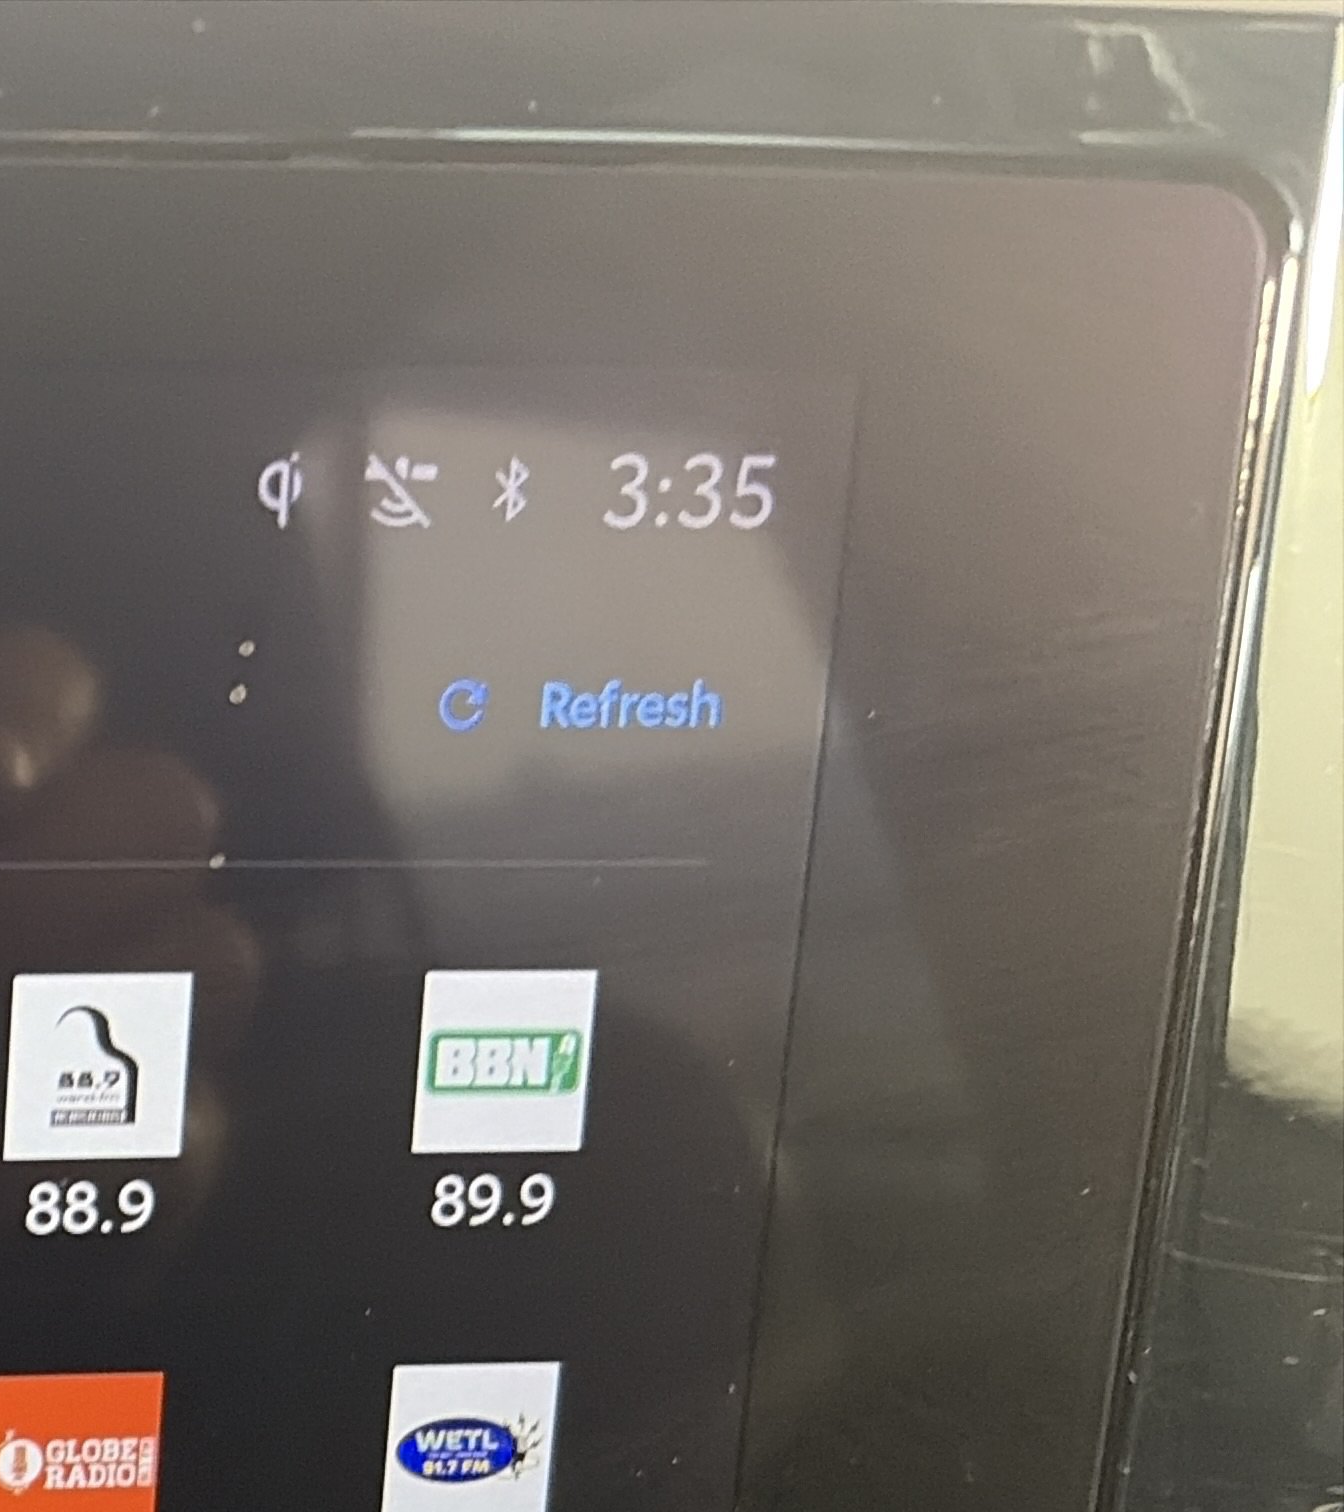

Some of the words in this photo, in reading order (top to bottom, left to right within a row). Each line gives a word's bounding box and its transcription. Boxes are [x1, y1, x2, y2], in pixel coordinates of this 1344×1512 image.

[603, 453, 778, 530] 3:35
[539, 677, 724, 729] Refresh
[434, 1036, 551, 1087] BBN
[25, 1178, 155, 1236] 88.9
[430, 1172, 556, 1228] 89.9
[45, 1437, 139, 1463] GLOBE
[414, 1428, 500, 1454] WETL
[43, 1462, 138, 1489] RADIO
